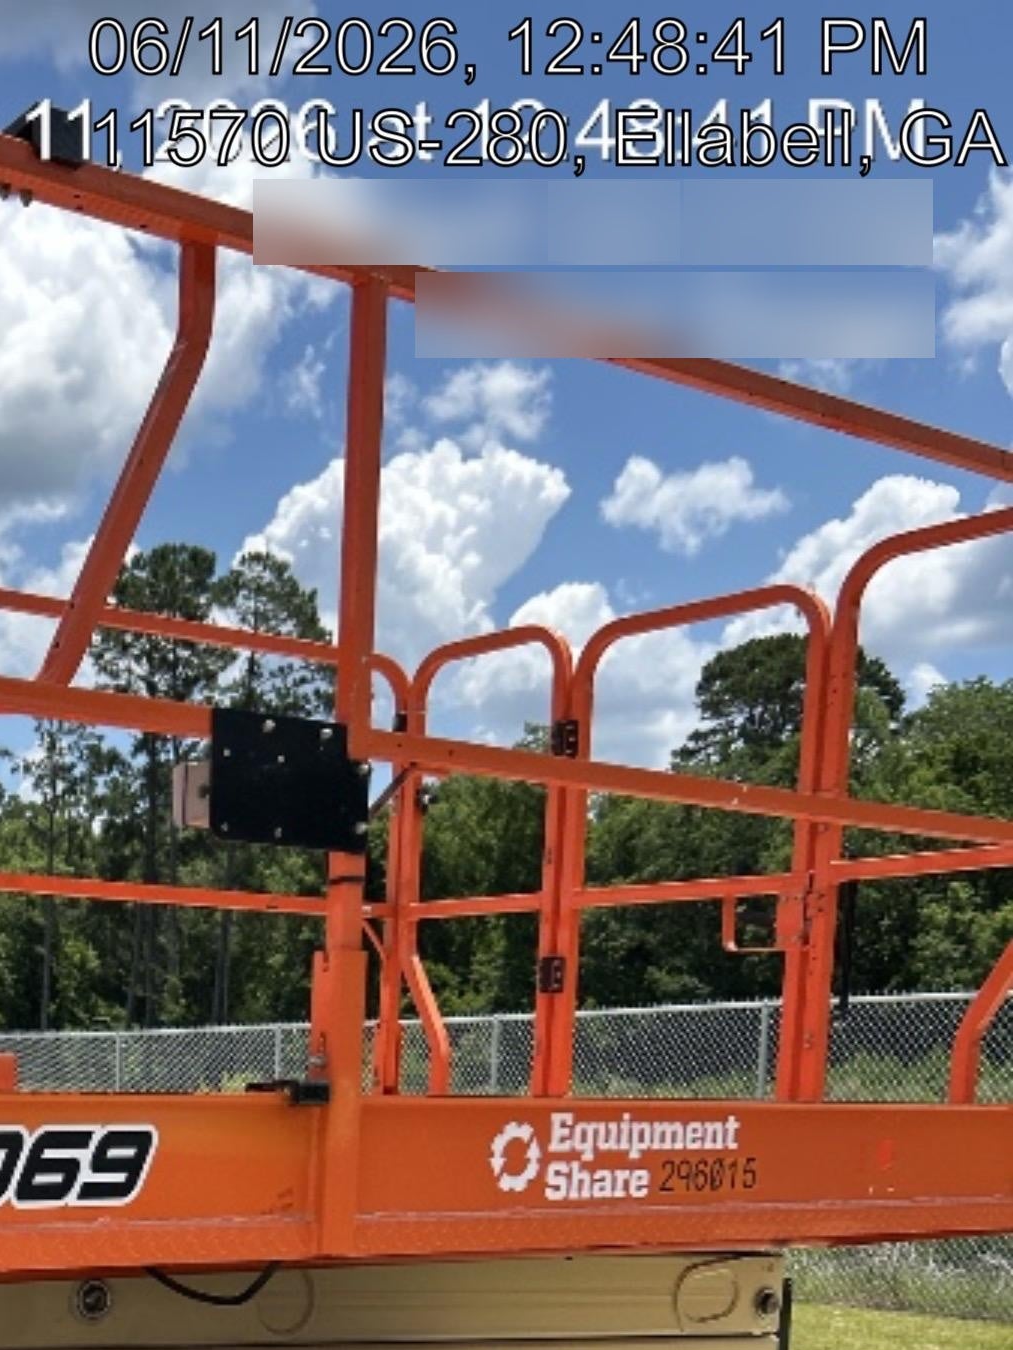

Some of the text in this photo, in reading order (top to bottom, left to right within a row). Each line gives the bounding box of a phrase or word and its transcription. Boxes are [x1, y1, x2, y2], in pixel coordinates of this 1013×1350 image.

[548, 1112, 741, 1158] Equipment
[545, 1161, 650, 1200] Share
[658, 1157, 758, 1193] 296015
